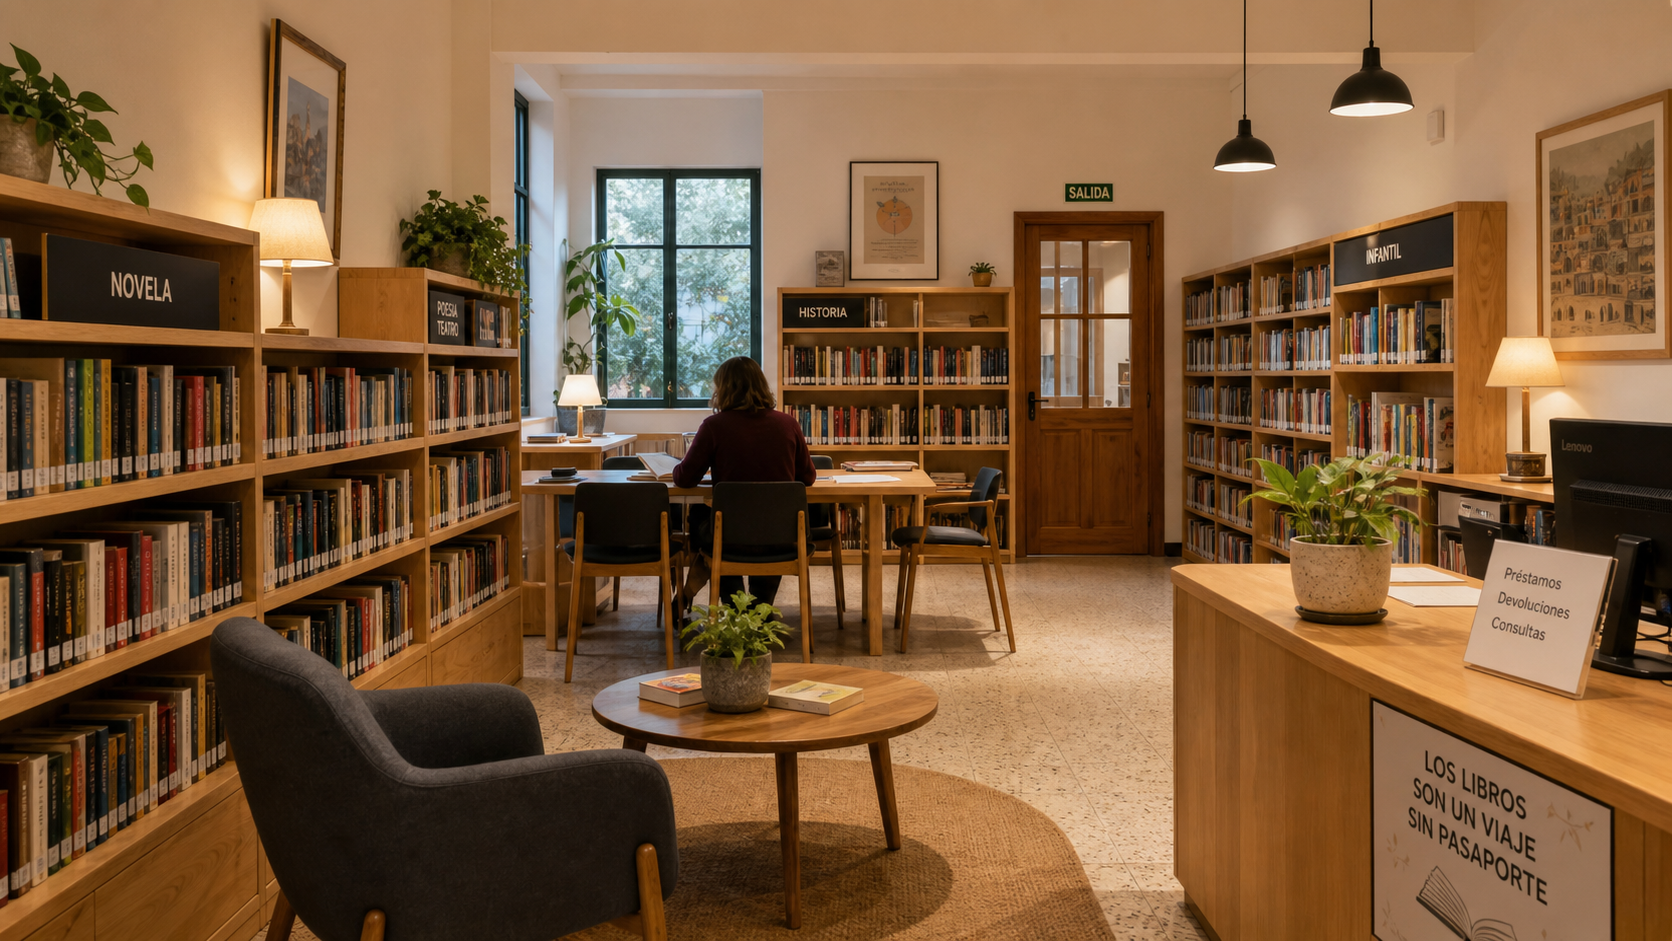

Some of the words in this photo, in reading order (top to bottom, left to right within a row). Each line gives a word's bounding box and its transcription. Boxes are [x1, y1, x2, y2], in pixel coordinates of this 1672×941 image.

[1068, 186, 1110, 200] SALIDA
[1365, 243, 1402, 265] INFANTIL
[110, 271, 173, 303] NOVELA
[798, 306, 848, 319] HISTORIA
[436, 320, 460, 337] TEATRO
[1561, 439, 1593, 454] Lenovo
[1504, 567, 1562, 590] Préstamos
[1497, 591, 1570, 620] Devoluciones
[1491, 616, 1546, 641] Consultas
[1425, 750, 1456, 784] LOS
[1462, 768, 1527, 820] LIBROS
[1413, 777, 1446, 814] SON
[1451, 796, 1476, 830] UN
[1481, 812, 1536, 863] VIAJE
[1408, 806, 1433, 839] SIN
[1438, 823, 1548, 906] PASAPORTE
